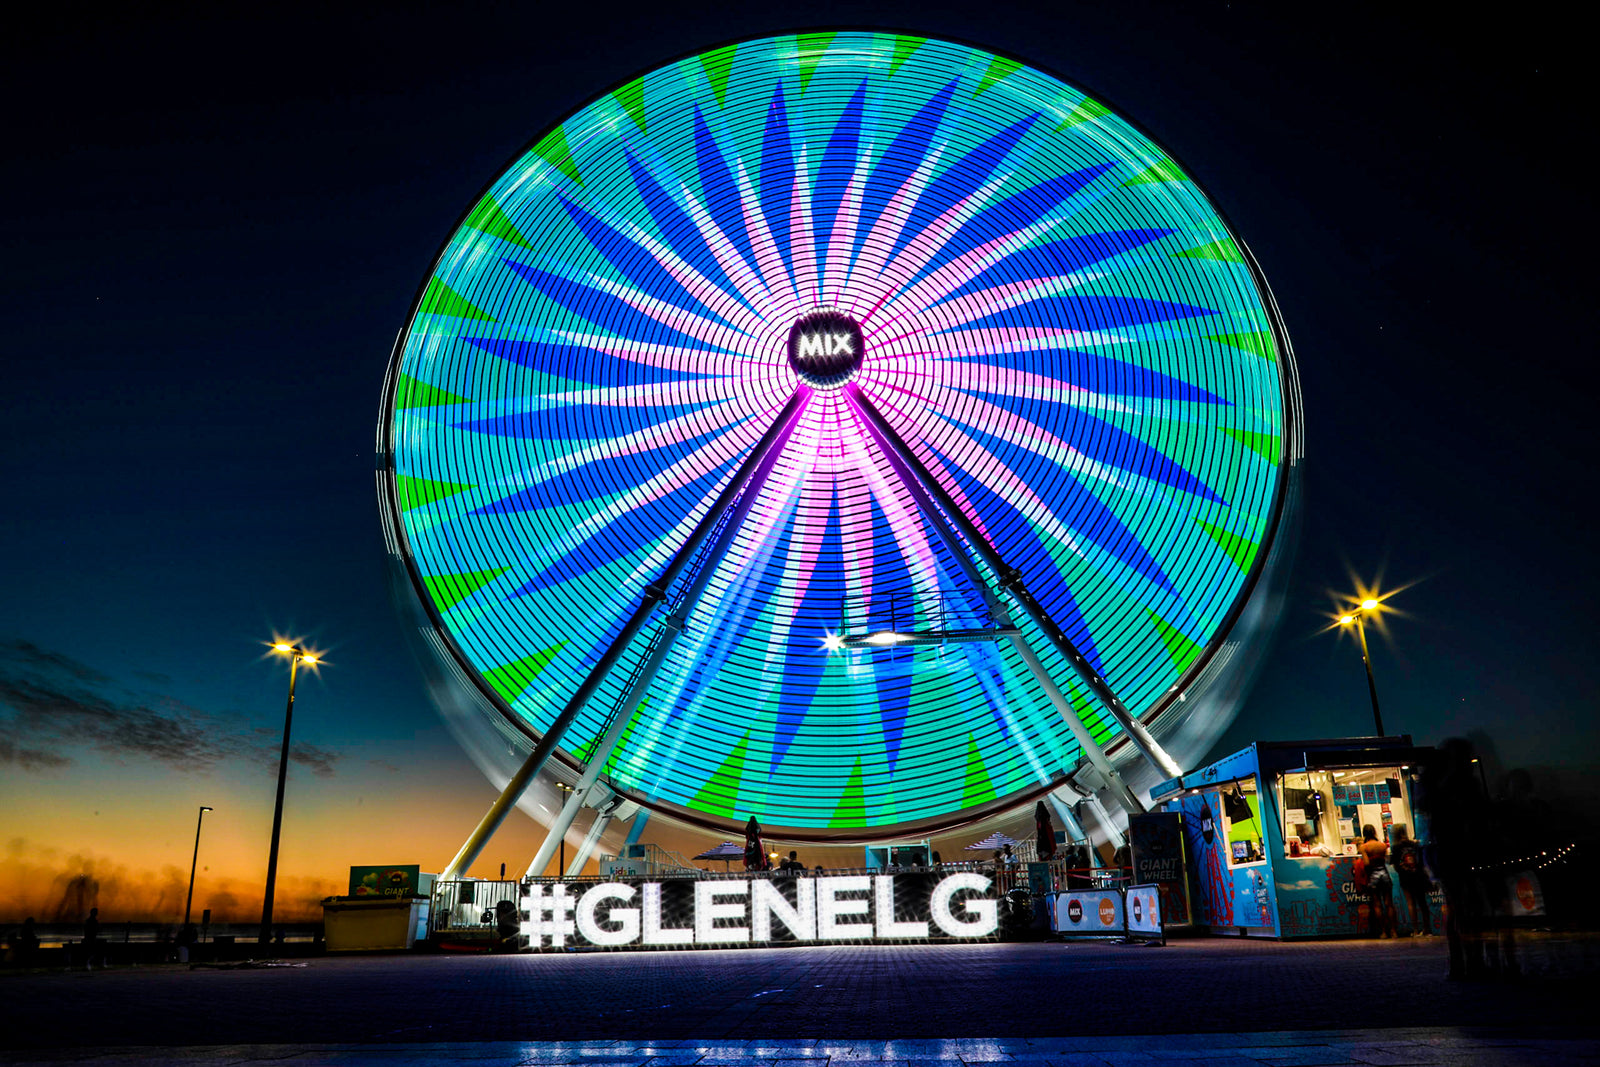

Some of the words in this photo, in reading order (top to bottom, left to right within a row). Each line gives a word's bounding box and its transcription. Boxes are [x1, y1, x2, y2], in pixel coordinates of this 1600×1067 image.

[798, 333, 853, 358] MIX
[1139, 858, 1179, 871] GIANT
[1143, 870, 1177, 880] WHEEL
[384, 888, 409, 896] GIANT
[519, 872, 999, 947] #GLENELG
[1069, 907, 1081, 917] MIX
